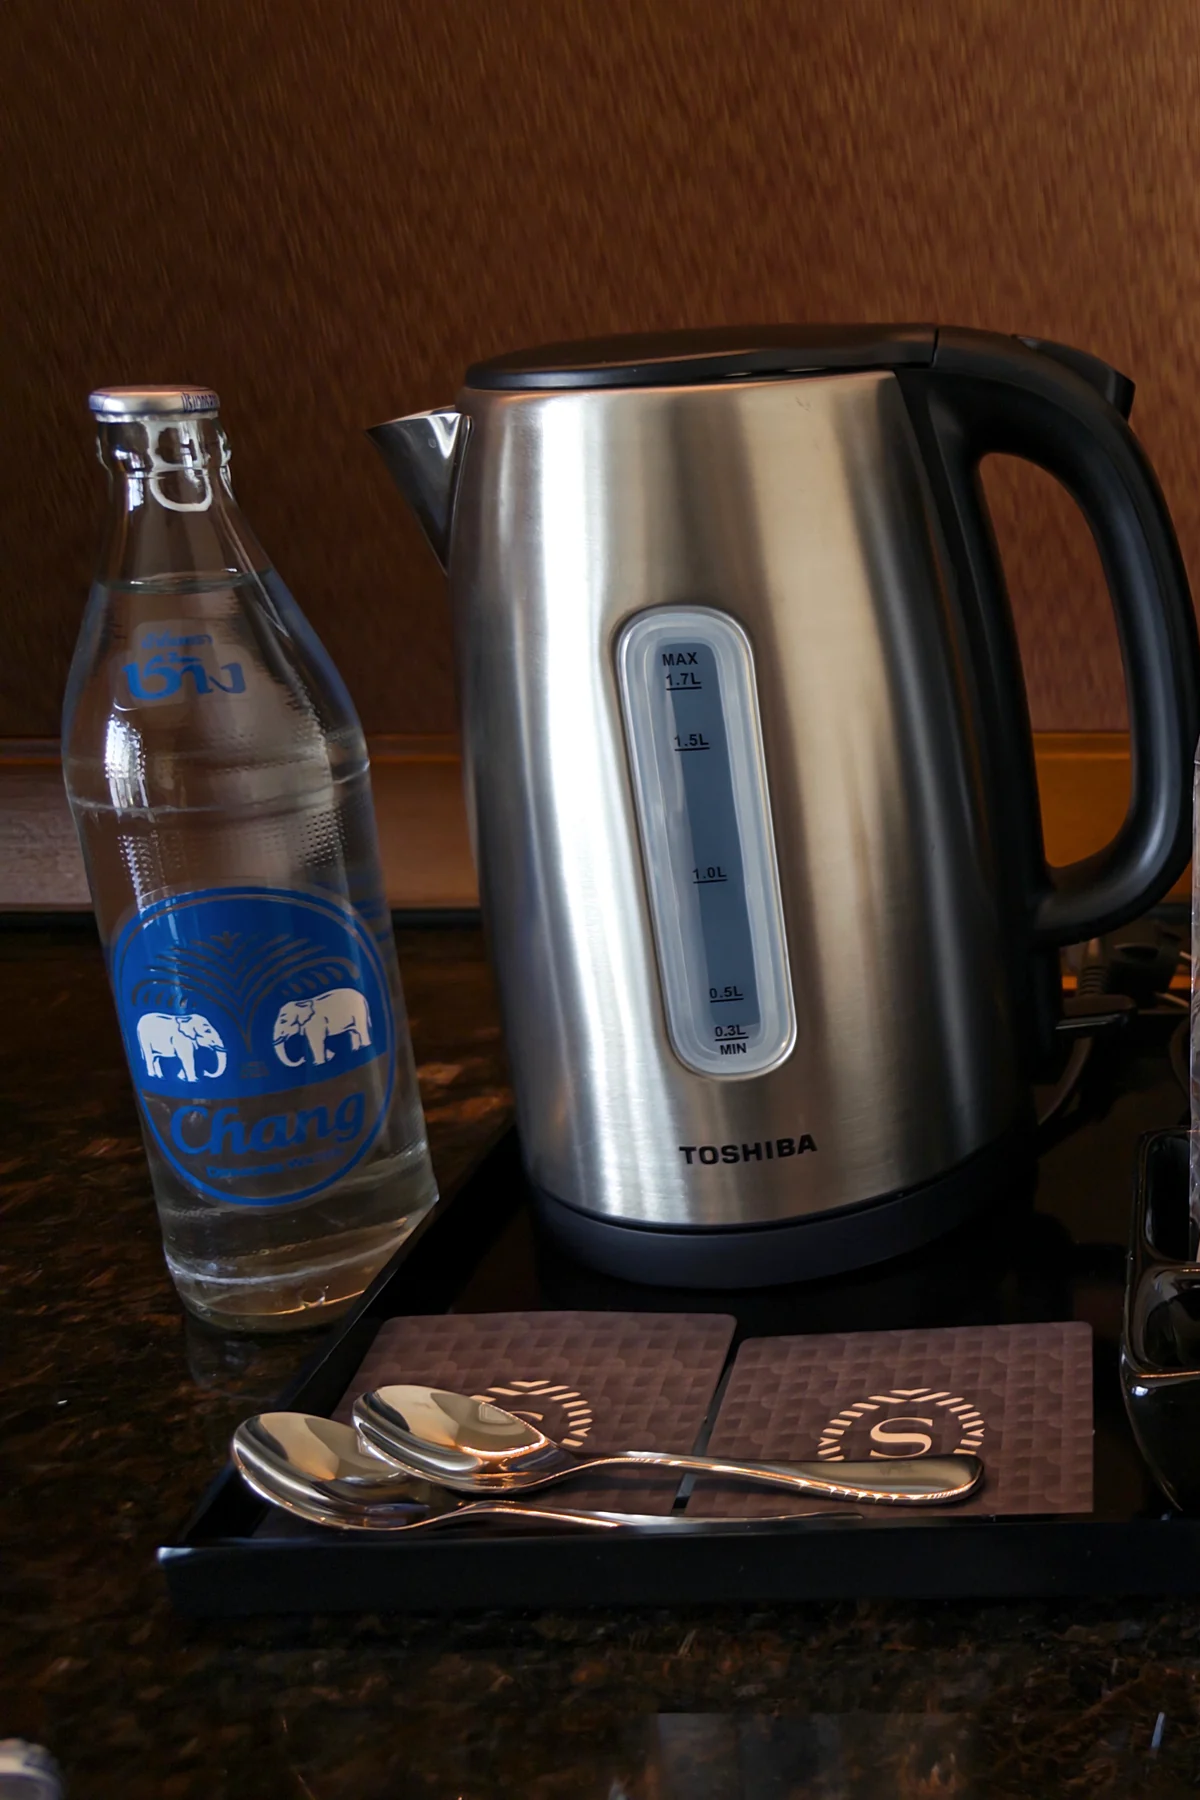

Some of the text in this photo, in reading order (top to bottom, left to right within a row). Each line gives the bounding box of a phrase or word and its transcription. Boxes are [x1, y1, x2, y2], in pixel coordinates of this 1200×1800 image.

[662, 652, 699, 667] MAX
[665, 672, 702, 687] 1.7L
[674, 733, 710, 748] 1.5L
[692, 866, 728, 881] 1.0L
[709, 985, 744, 999] 0.5L
[714, 1024, 747, 1038] 0.3L
[719, 1042, 747, 1056] MIN
[169, 1092, 367, 1156] Chang
[679, 1133, 818, 1165] TOSHIBA
